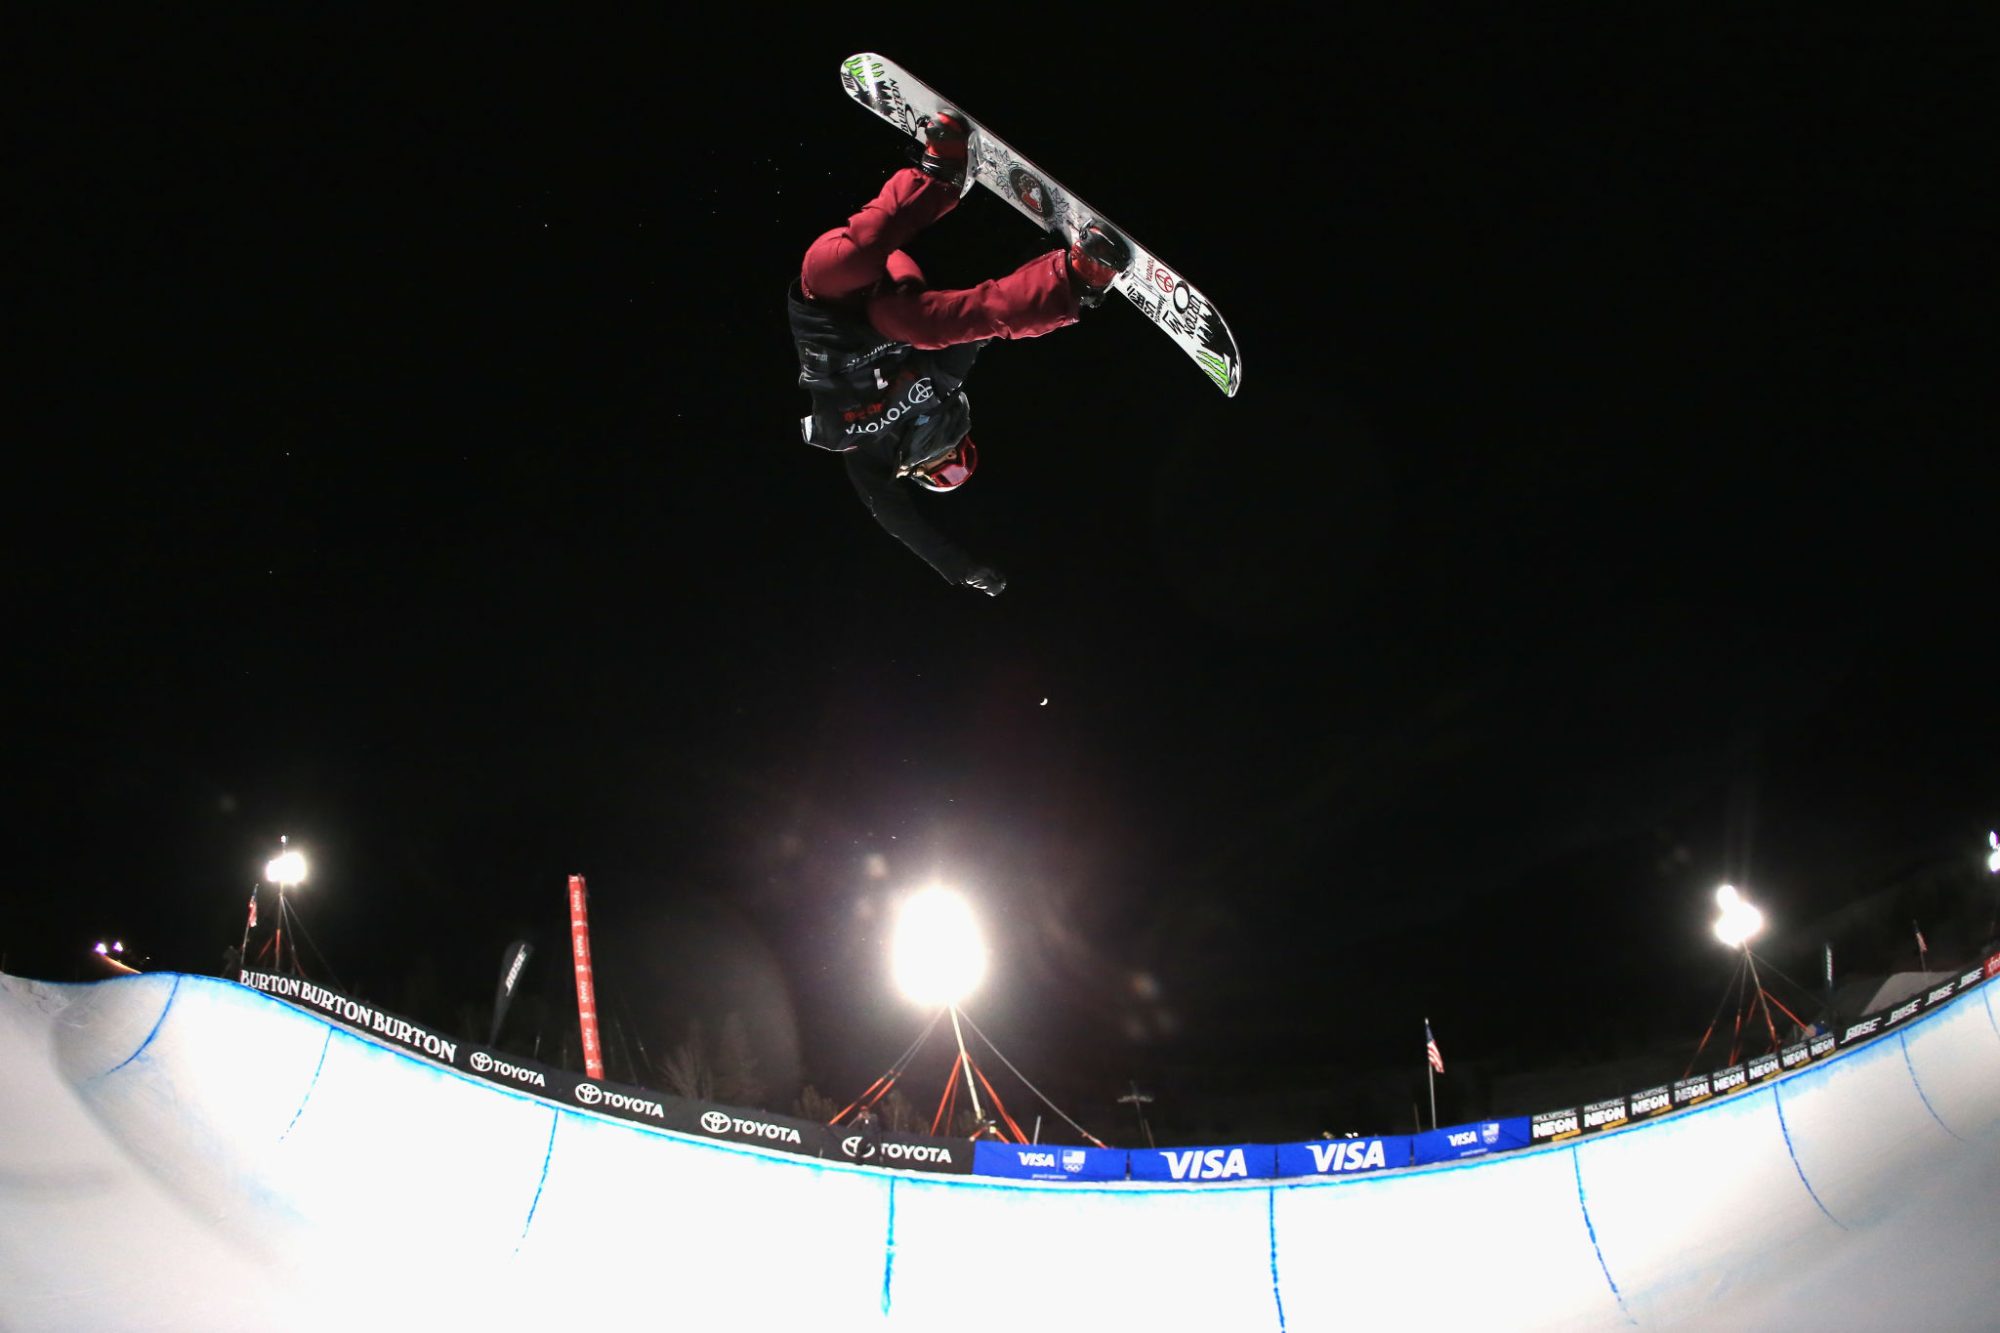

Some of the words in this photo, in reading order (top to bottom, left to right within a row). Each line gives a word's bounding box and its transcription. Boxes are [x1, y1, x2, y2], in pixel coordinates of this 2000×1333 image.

[889, 78, 909, 132] BURTON
[845, 400, 911, 435] TOYOTA
[1925, 982, 1955, 1006] BOSE
[240, 969, 301, 997] BURTON
[301, 981, 373, 1027] BURTON
[373, 1011, 457, 1063] BURTON
[1884, 998, 1921, 1027] BOSE
[1840, 1016, 1882, 1044] BOSE
[1782, 1048, 1809, 1067] NEON
[1811, 1037, 1835, 1056] NEON
[493, 1060, 546, 1087] TOYOTA
[1749, 1059, 1780, 1079] NEON
[1674, 1082, 1709, 1103] NEON
[1713, 1070, 1746, 1092] NEON
[602, 1091, 664, 1118] TOYOTA
[1631, 1093, 1669, 1115] NEON
[1532, 1116, 1578, 1138] NEON
[1584, 1105, 1626, 1127] NEON
[731, 1118, 801, 1144] TOYOTA
[1447, 1131, 1478, 1147] VISA
[881, 1143, 952, 1164] TOYOTA
[1017, 1152, 1055, 1167] VISA
[1160, 1148, 1248, 1179] VISA
[1305, 1140, 1385, 1172] VISA
